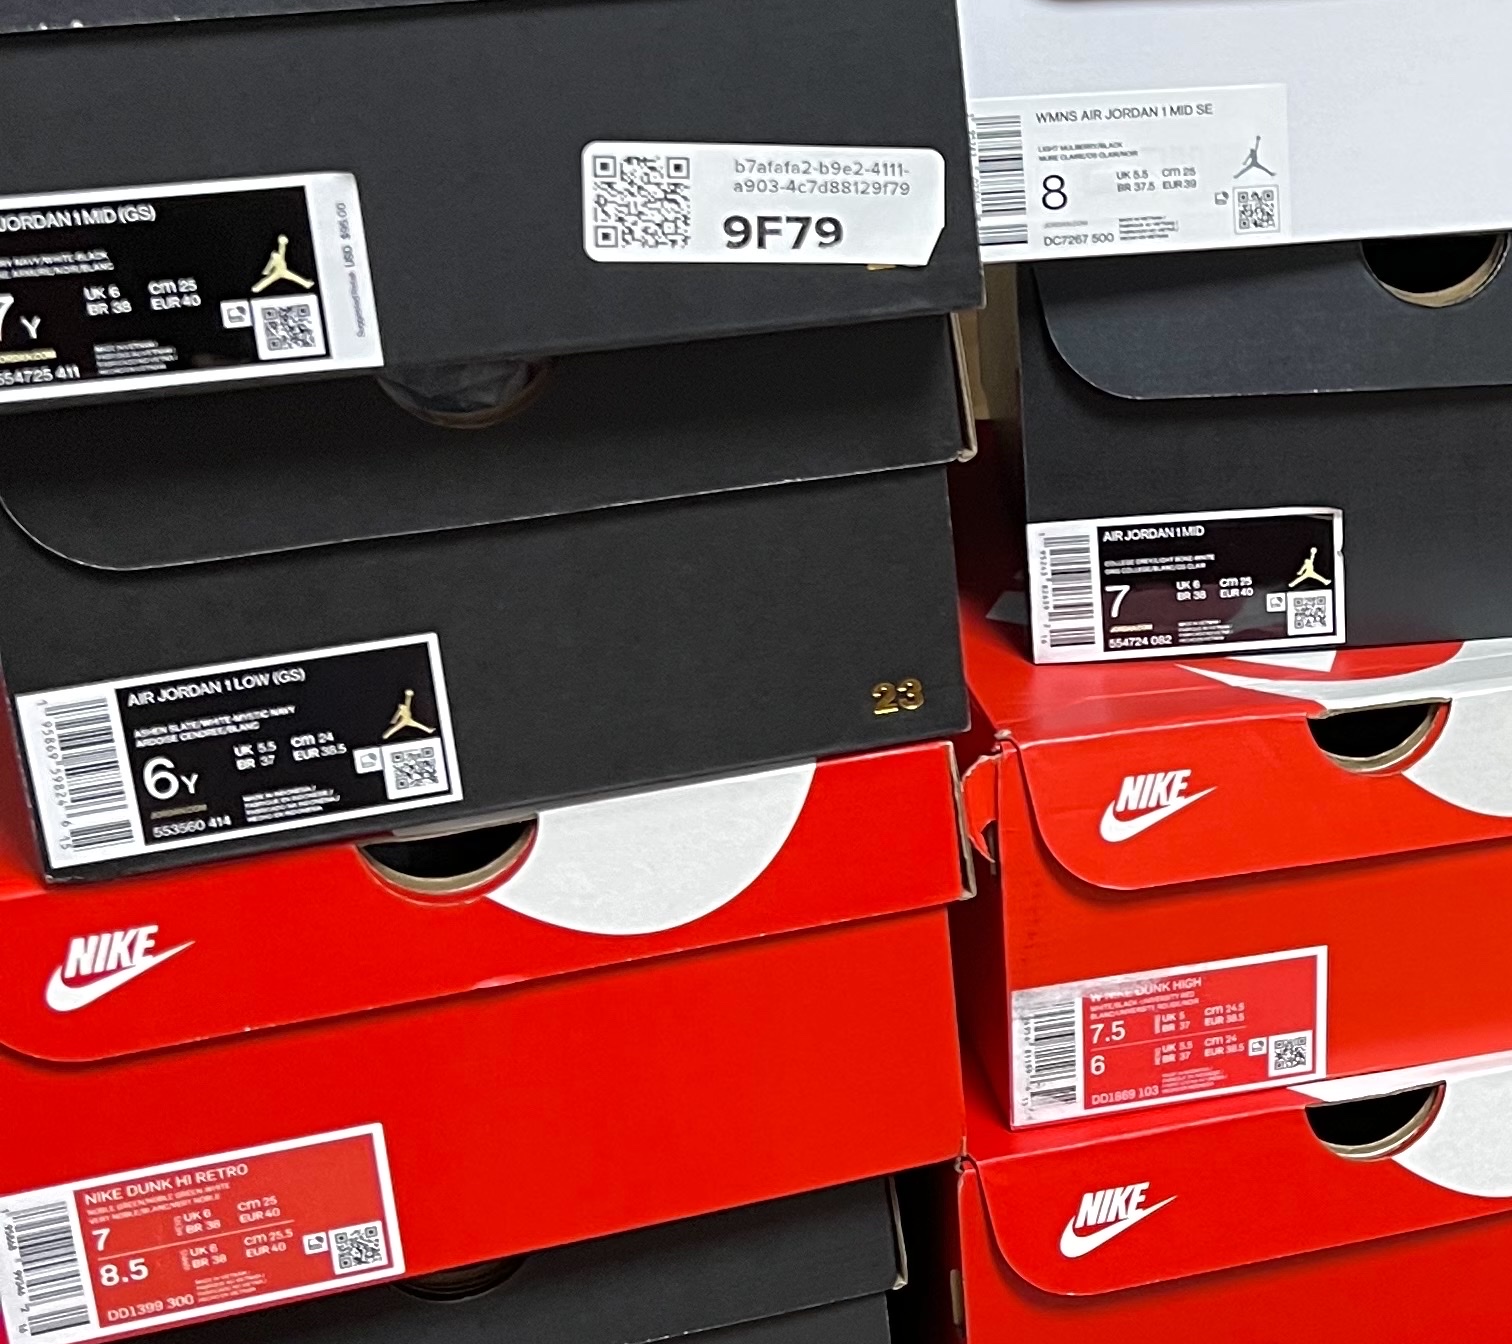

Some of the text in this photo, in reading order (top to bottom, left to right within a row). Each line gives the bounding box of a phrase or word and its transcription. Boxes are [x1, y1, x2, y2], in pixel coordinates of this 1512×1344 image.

[1036, 103, 1213, 124] WMNS AIR JORDAN 1 MID SE
[734, 158, 910, 177] b7afafa2-b9e2-4111-
[1115, 169, 1132, 181] UK
[1161, 168, 1181, 179] cm
[733, 178, 911, 197] a903-4c7d88129f79
[1042, 174, 1068, 211] 8
[1162, 179, 1184, 191] EUR
[73, 209, 82, 226] 1
[82, 206, 117, 226] MID
[117, 203, 156, 225] (GS)
[722, 214, 845, 251] 9F79
[1043, 232, 1115, 248] DC7267 500
[342, 245, 355, 268] USD
[83, 283, 121, 301] UK 6
[148, 277, 198, 296] cm 25
[86, 297, 132, 317] BR 38
[150, 293, 202, 311] EUR 40
[54, 363, 81, 380] 411
[1102, 524, 1206, 543] AIR JORDAN 1 MID
[1176, 580, 1192, 591] UK
[1219, 577, 1239, 589] cm
[1219, 586, 1254, 599] EUR 40
[1104, 584, 1131, 618] 7
[1108, 637, 1149, 649] 554724
[126, 666, 306, 708] AIR JORDAN 1 LOW (GS)
[873, 678, 926, 715] 23
[289, 730, 334, 748] cm 24
[233, 740, 278, 758] UK 5.5
[292, 747, 320, 762] EUR
[236, 753, 277, 773] BR 37
[1115, 769, 1192, 812] NIKE
[152, 814, 233, 839] 553560 414
[63, 924, 159, 980] NIKE
[1134, 976, 1203, 997] DUNK HIGH
[1089, 1020, 1127, 1045] 7.5
[1089, 1054, 1106, 1076] 6
[1138, 1084, 1160, 1098] 103
[84, 1187, 124, 1206] NIKE
[125, 1178, 174, 1199] DUNK
[174, 1173, 193, 1187] HI
[194, 1162, 249, 1184] RETRO
[236, 1195, 279, 1213] cm 25
[1074, 1181, 1150, 1229] NIKE
[183, 1207, 213, 1224] UK 6
[239, 1207, 282, 1225] EUR 40
[92, 1228, 112, 1252] 7
[243, 1227, 294, 1248] cm 25.5
[190, 1245, 210, 1258] UK
[245, 1241, 288, 1258] EUR 40
[100, 1257, 150, 1287] 8.5
[107, 1292, 196, 1322] DD1399 300
